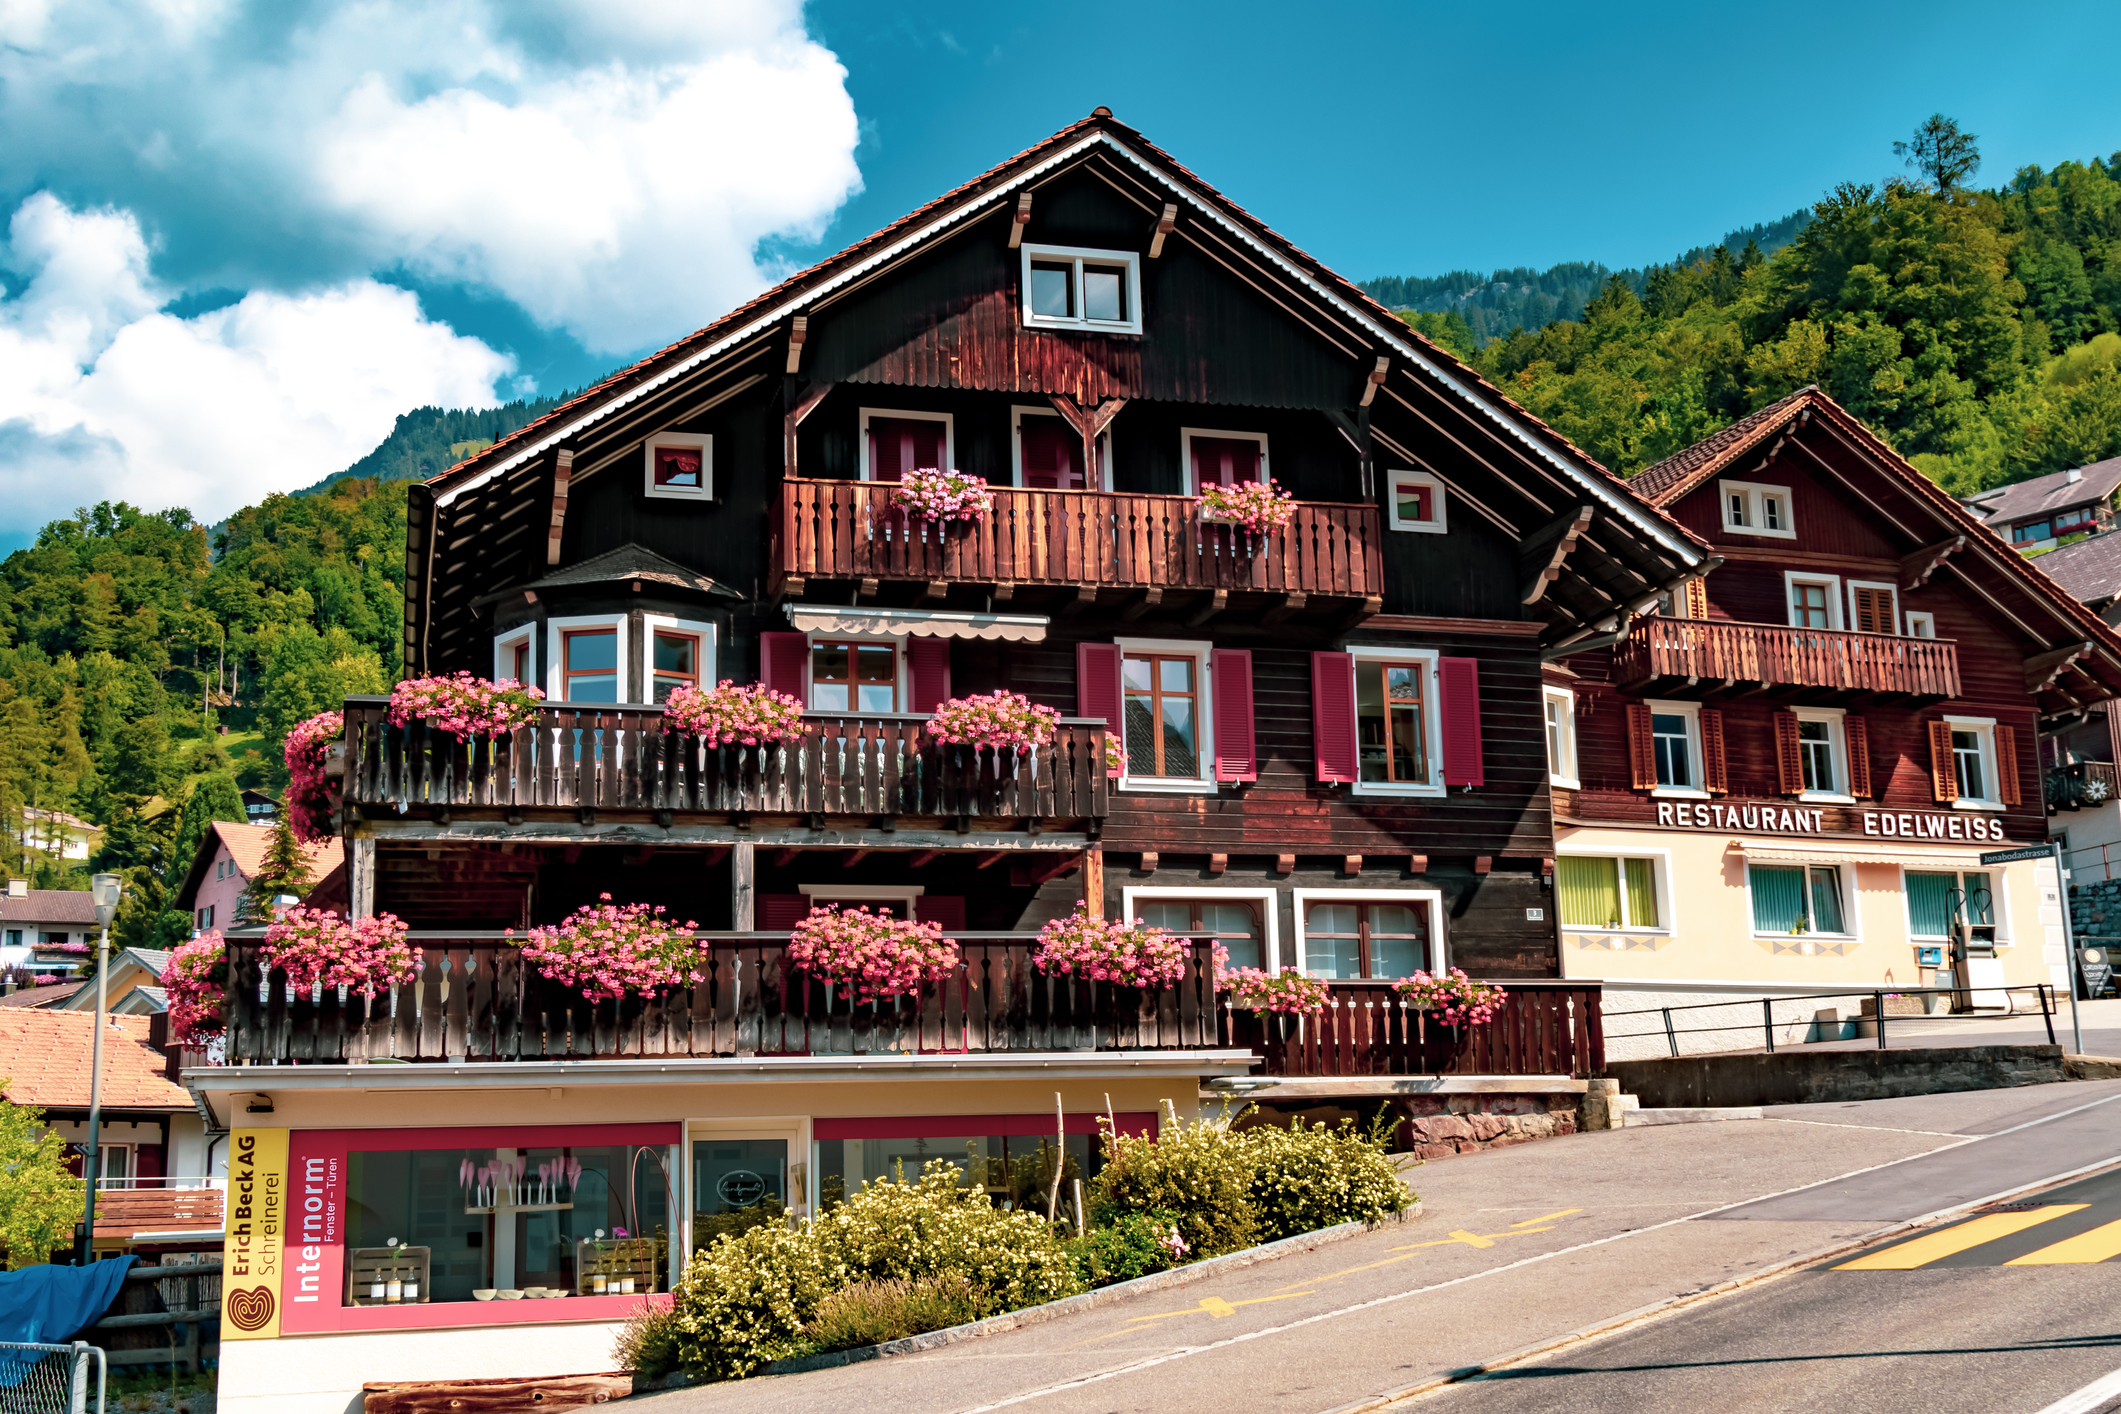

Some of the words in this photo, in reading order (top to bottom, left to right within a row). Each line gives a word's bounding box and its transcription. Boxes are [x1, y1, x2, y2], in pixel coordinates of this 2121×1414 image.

[1657, 802, 1824, 832] RESTAURANT
[1863, 812, 2004, 841] EDELWEISS
[1984, 849, 2050, 863] Jonabodastrasse
[237, 1136, 256, 1167] AG
[326, 1158, 338, 1189] Türen
[235, 1170, 254, 1219] Beck
[258, 1173, 279, 1276] Schreinerei
[293, 1158, 325, 1303] Internorm
[324, 1201, 336, 1242] Fenster
[232, 1223, 252, 1276] Erich
